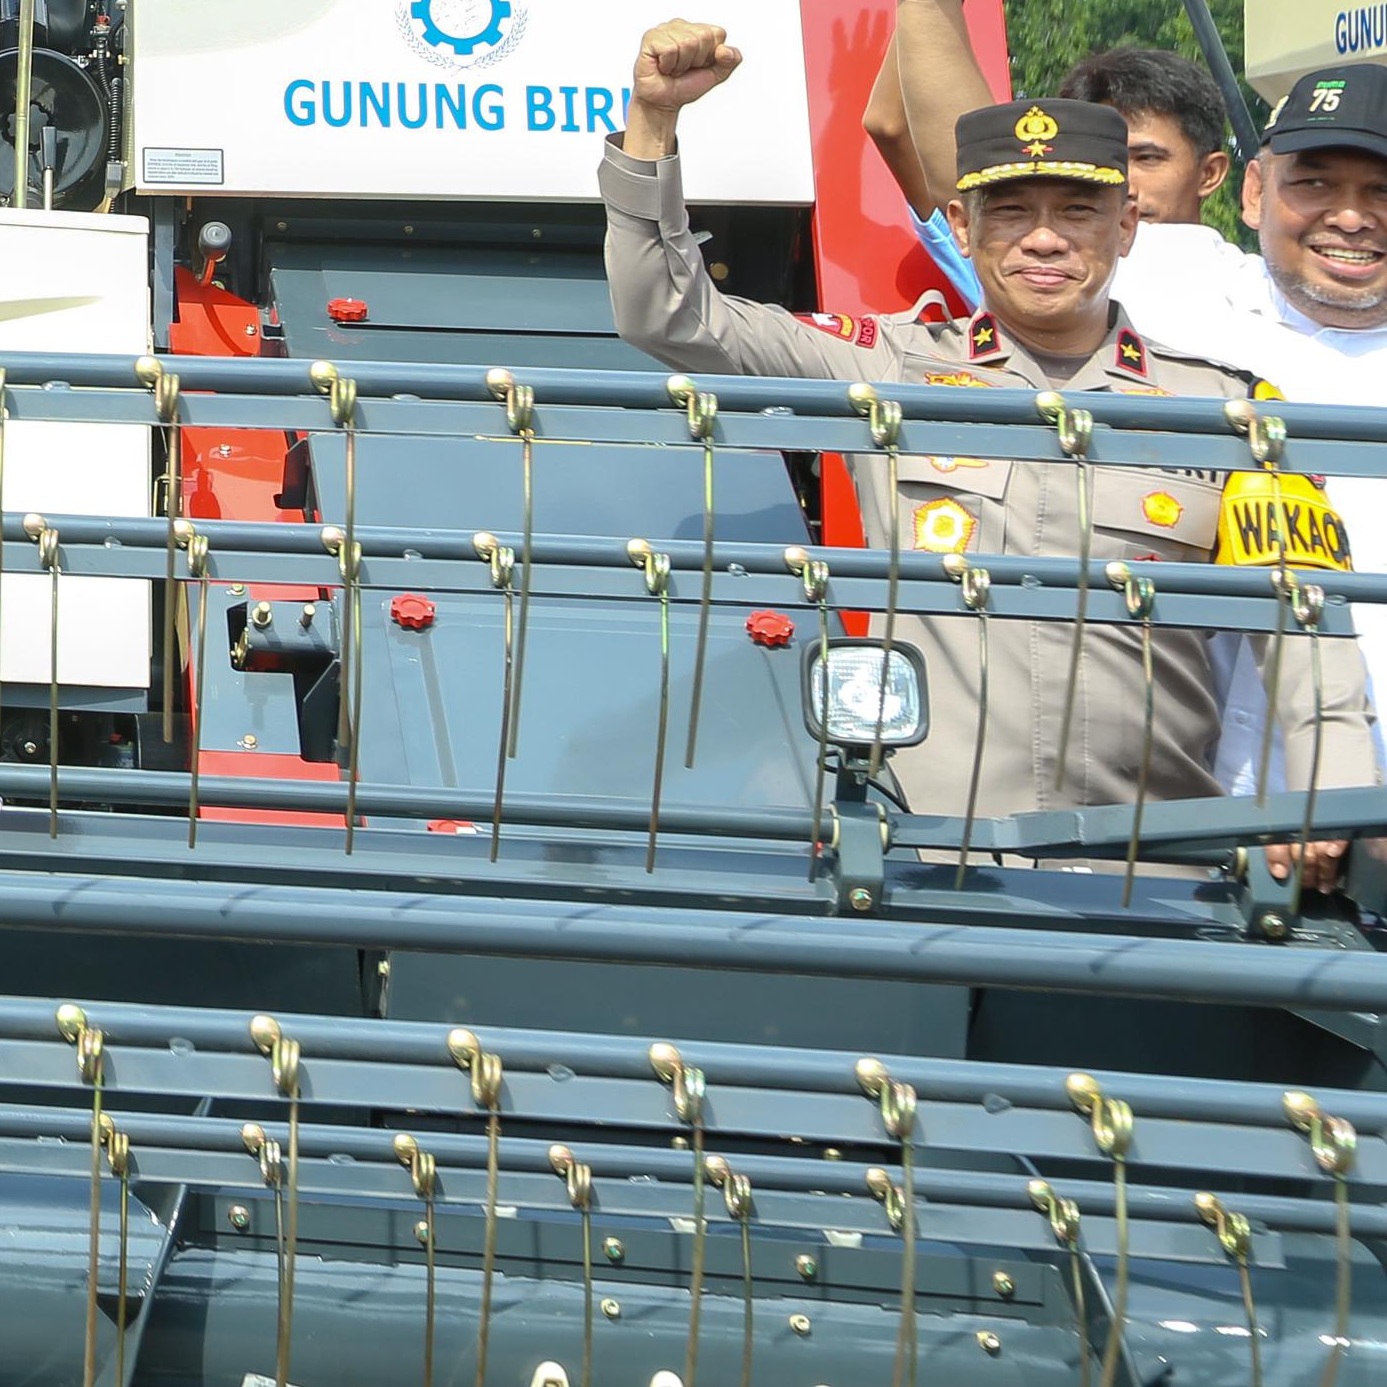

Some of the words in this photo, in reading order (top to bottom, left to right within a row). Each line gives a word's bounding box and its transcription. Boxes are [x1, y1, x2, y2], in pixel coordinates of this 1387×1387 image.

[1335, 1, 1387, 55] GUNU
[283, 79, 506, 131] GUNUNG
[525, 85, 631, 133] BIR
[1308, 89, 1343, 112] 75
[1233, 500, 1350, 563] WAKAO
